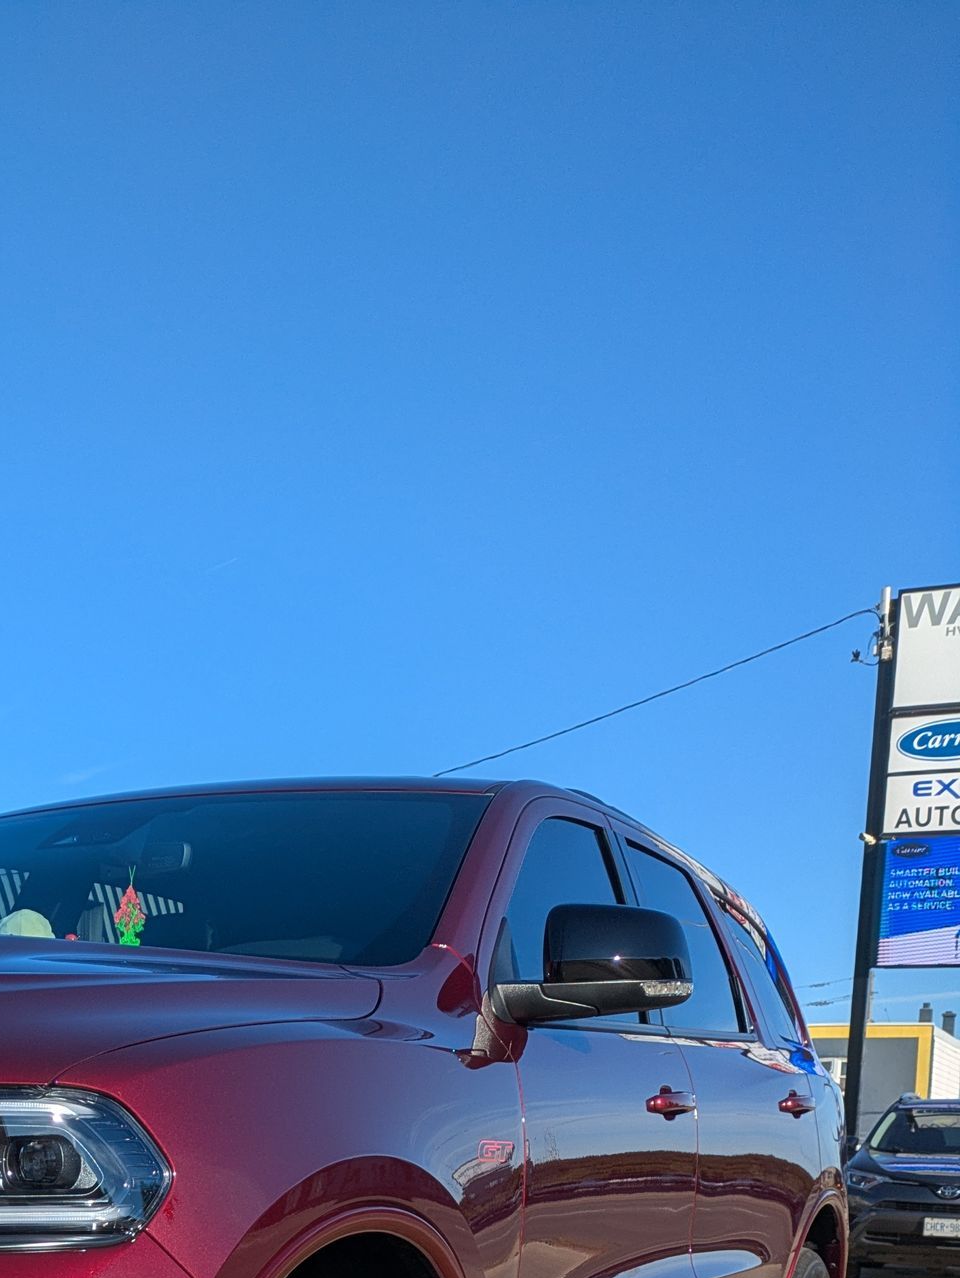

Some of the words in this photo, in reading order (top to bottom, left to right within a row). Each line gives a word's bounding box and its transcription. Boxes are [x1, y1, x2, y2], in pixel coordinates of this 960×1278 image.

[890, 868, 937, 877] SMARTER
[888, 891, 911, 900] NOW
[887, 903, 900, 911] AS
[902, 902, 909, 911] A
[478, 1140, 513, 1162] GT
